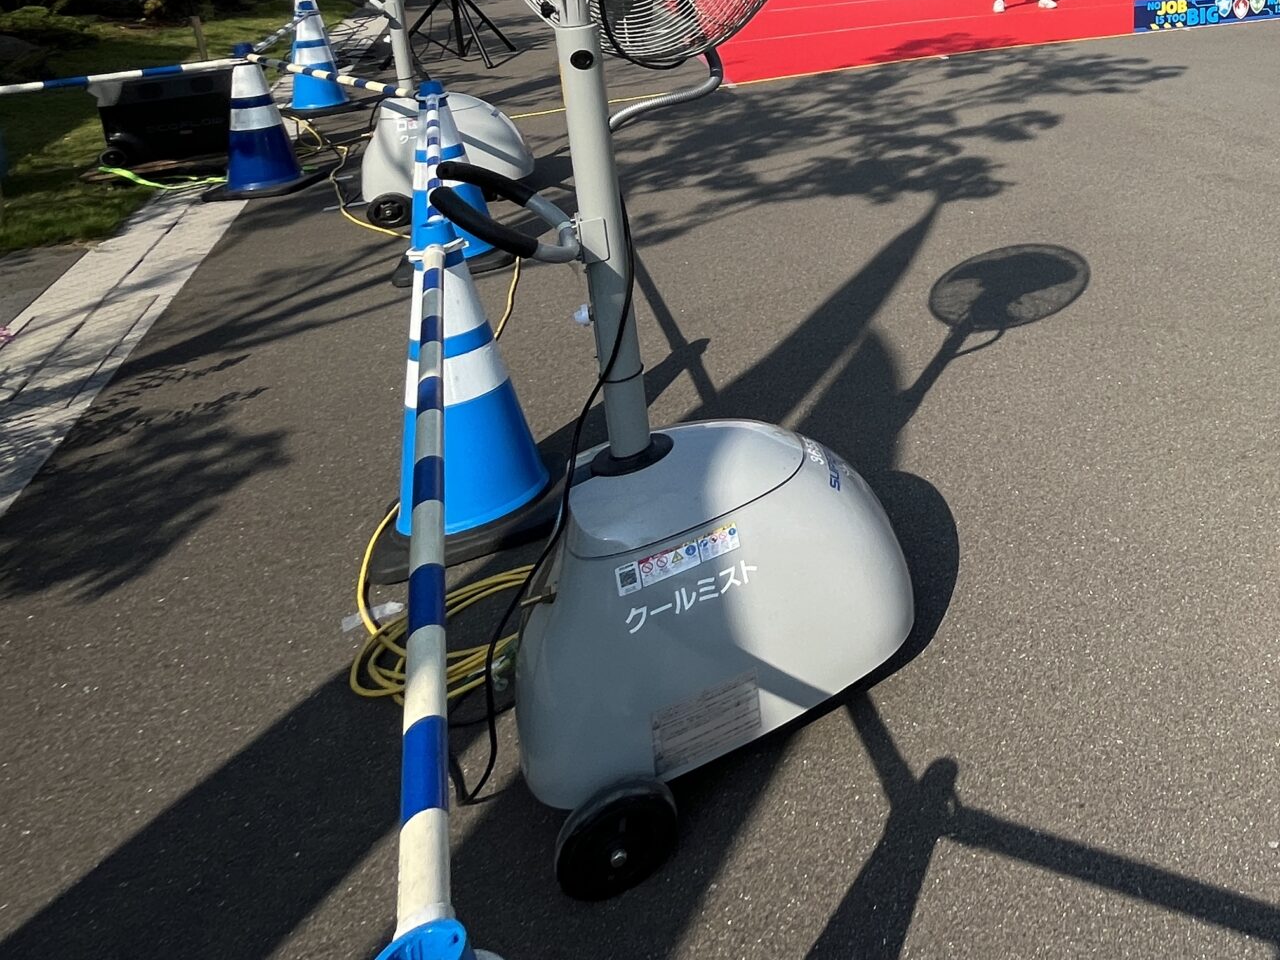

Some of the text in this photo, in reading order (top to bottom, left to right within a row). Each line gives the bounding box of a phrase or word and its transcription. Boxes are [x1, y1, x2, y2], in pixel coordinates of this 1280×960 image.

[1147, 0, 1187, 15] NO JOB
[1155, 6, 1219, 26] IS TOO BIG
[625, 559, 758, 634] クールミスト
